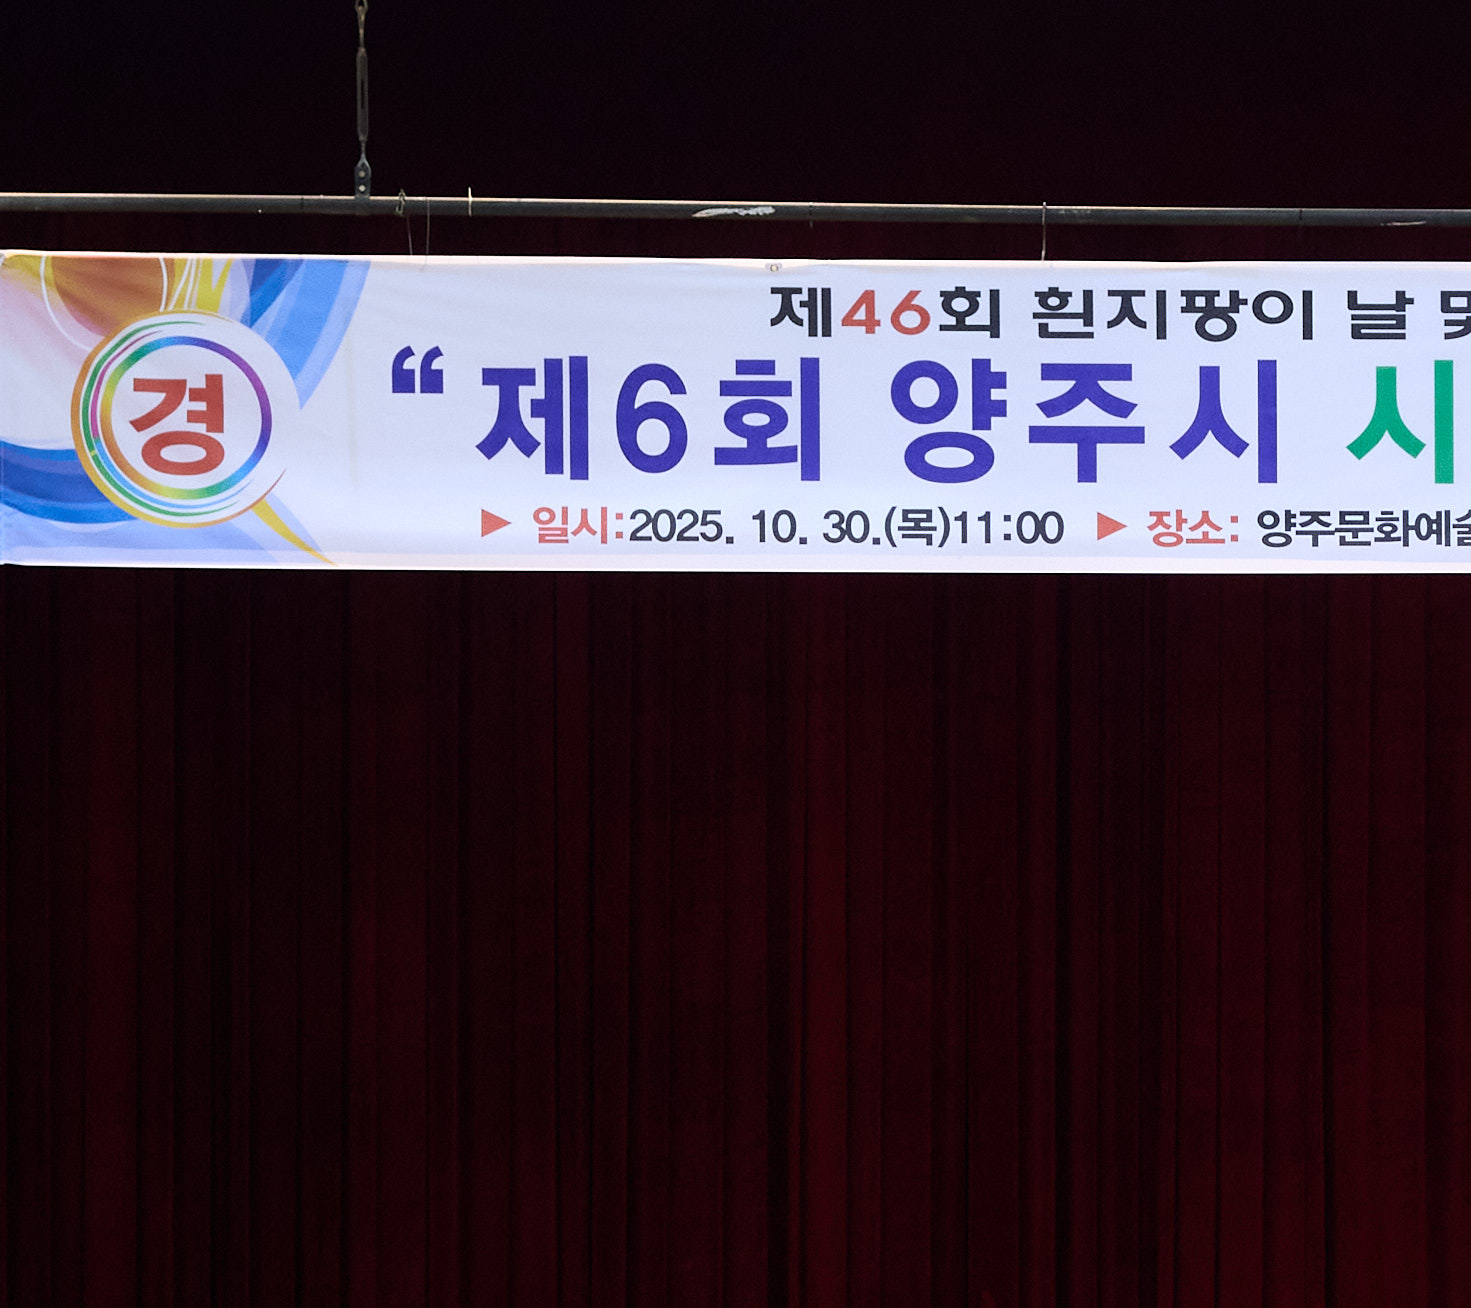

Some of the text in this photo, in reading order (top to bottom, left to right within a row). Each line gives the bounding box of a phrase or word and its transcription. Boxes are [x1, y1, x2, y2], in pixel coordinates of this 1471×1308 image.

[769, 285, 1001, 339] 제46회
[1032, 286, 1314, 343] 흰지팡이
[1346, 289, 1415, 341] 날
[130, 374, 226, 475] 경
[890, 357, 1278, 484] 양주시
[751, 509, 808, 545] 10.
[1147, 509, 1239, 548] 장소:
